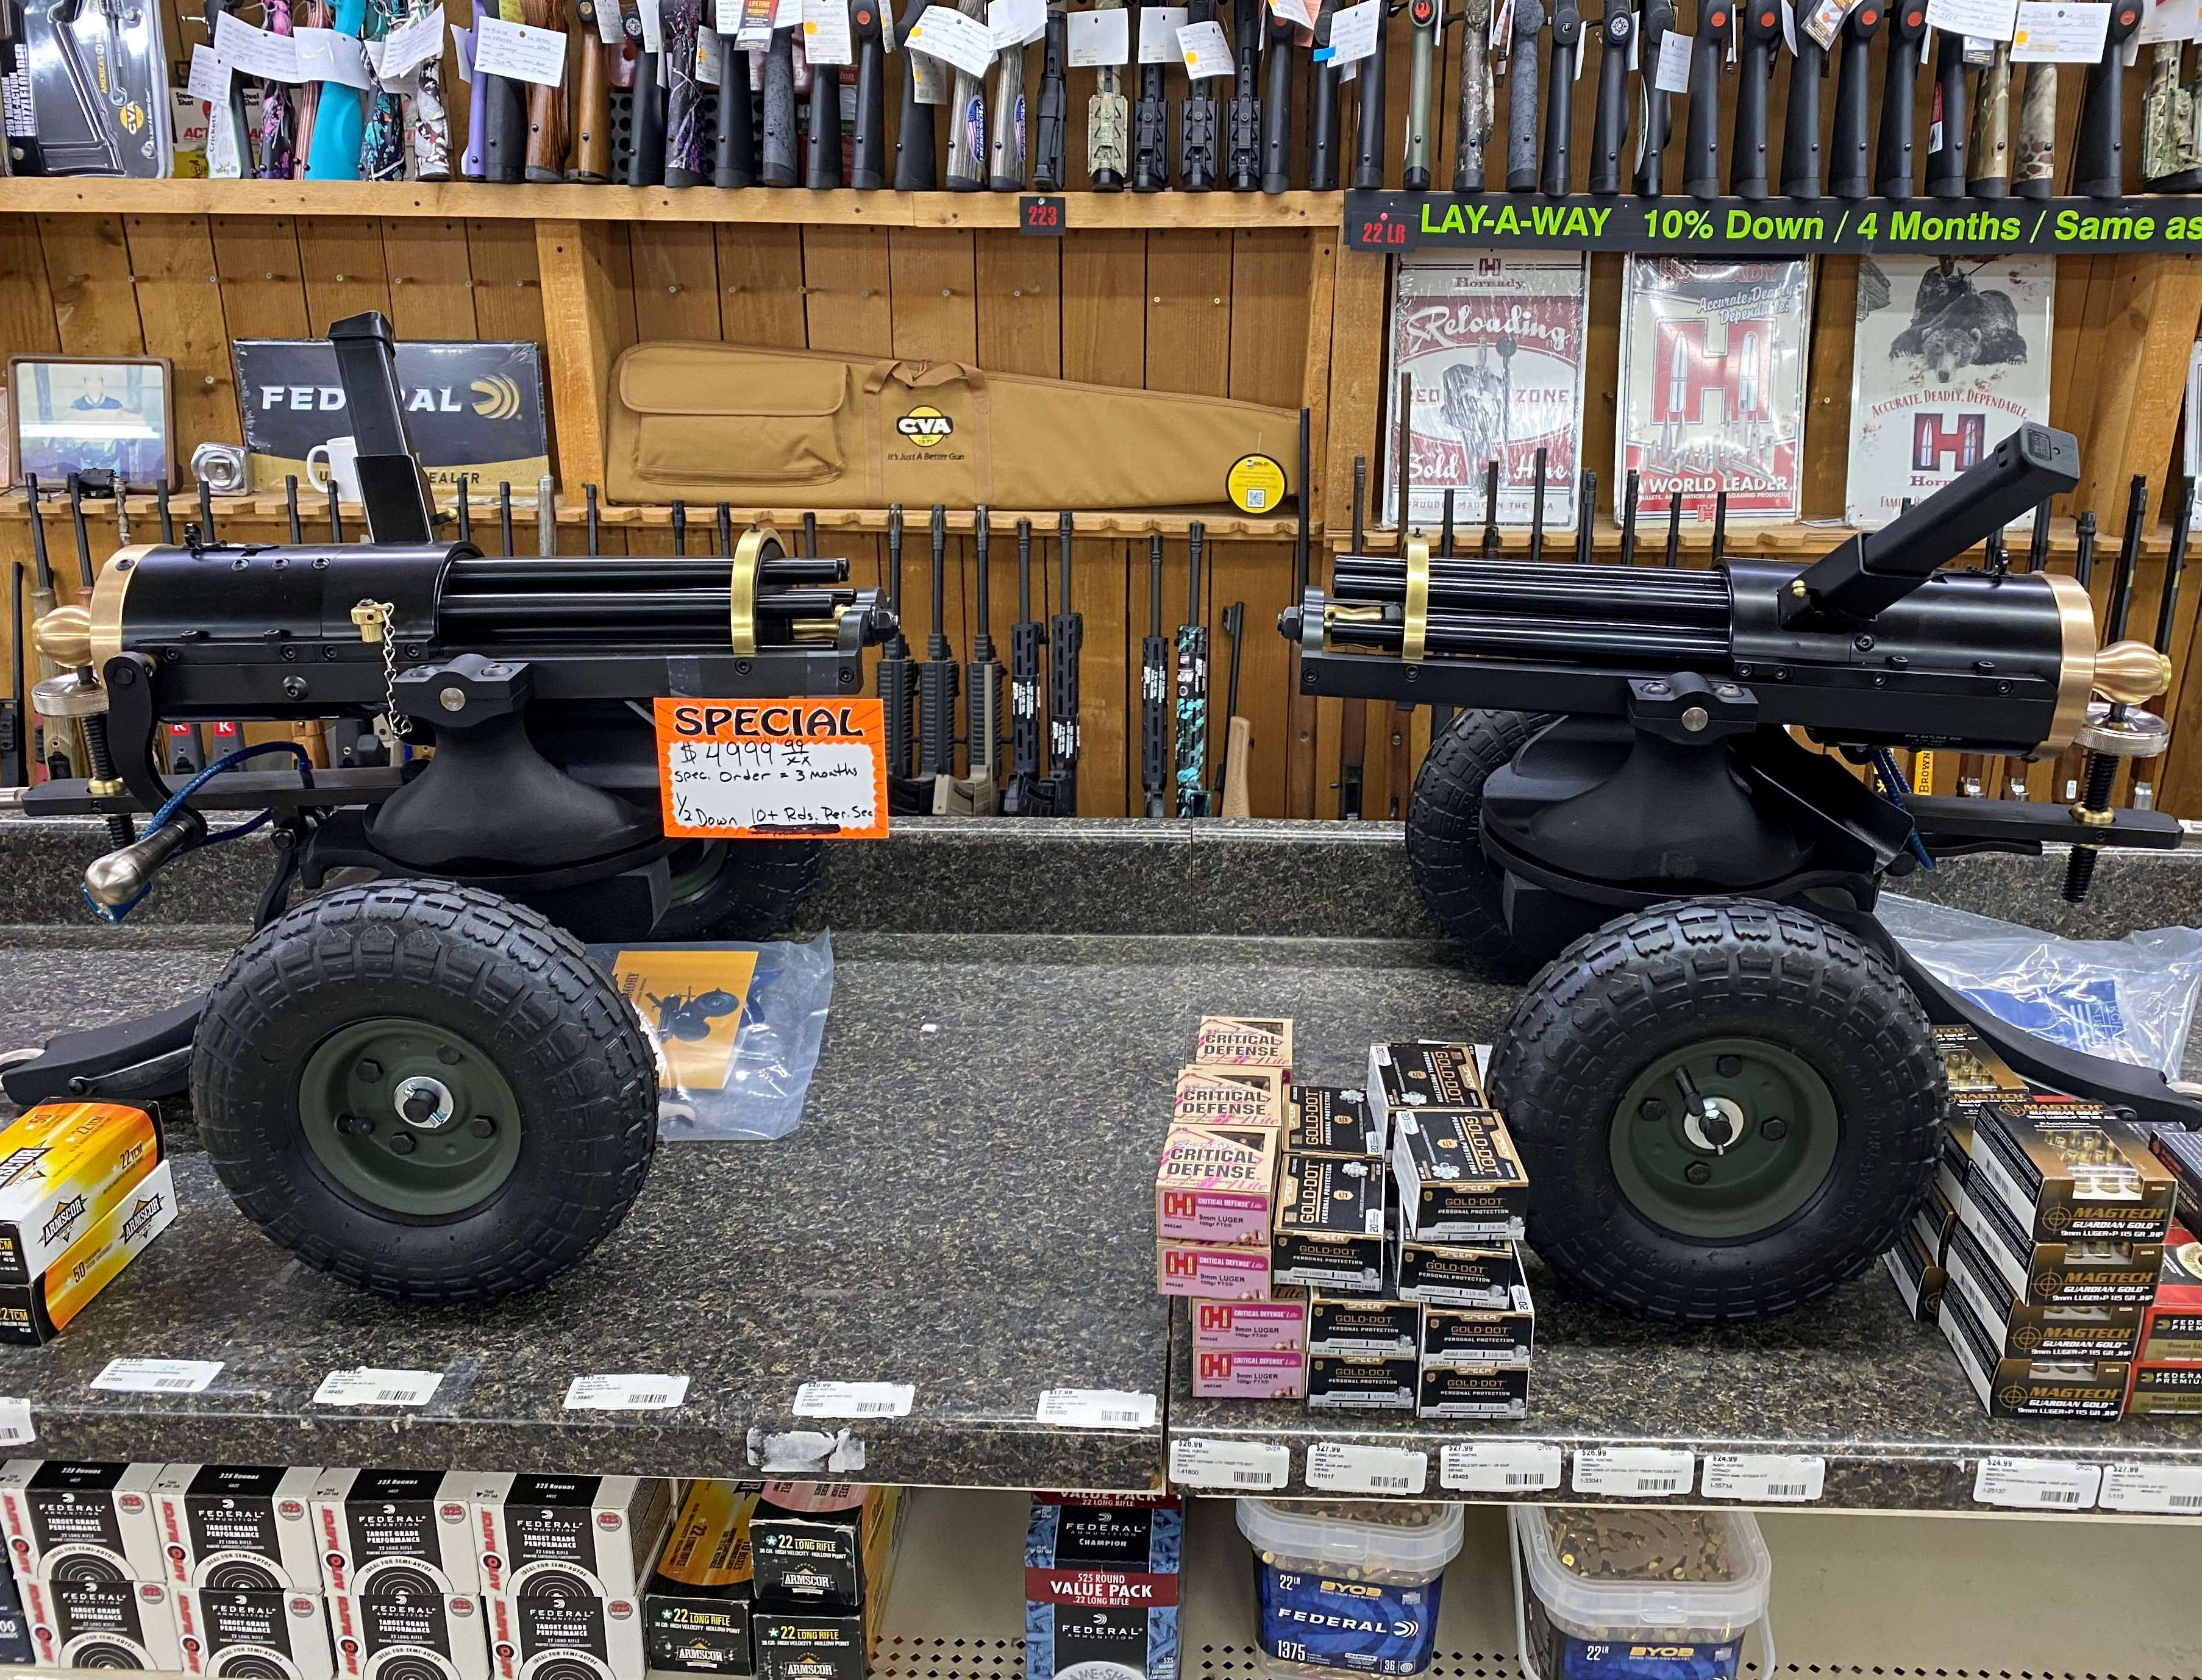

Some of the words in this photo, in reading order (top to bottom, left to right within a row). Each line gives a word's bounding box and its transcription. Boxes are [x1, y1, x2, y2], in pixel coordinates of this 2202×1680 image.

[1, 77, 13, 117] MAGNUM
[15, 44, 36, 137] MUZZLELOADER
[9, 73, 24, 137] BREAK-ACTION
[127, 101, 137, 135] CVA
[6, 119, 15, 137] 209
[1028, 205, 1058, 226] 223
[1420, 203, 1612, 237] LAY-A-WAY
[1644, 209, 1714, 240] 10%
[1726, 210, 1825, 240] Down
[1833, 210, 1850, 243] /
[1857, 212, 1878, 240] 4
[1889, 211, 2021, 241] Months
[2029, 210, 2047, 243] /
[2054, 210, 2156, 241] Same
[2165, 215, 2202, 241] as
[1361, 222, 1383, 243] 22
[1386, 224, 1405, 243] LR
[1453, 277, 1525, 290] Hornady
[1406, 305, 1571, 355] Reloading
[258, 385, 462, 412] FEDAL
[1516, 389, 1570, 404] ZONE
[1924, 390, 1964, 403] DEADLY.
[1967, 390, 2028, 420] DEPENDABLE.
[899, 418, 952, 433] CVA
[428, 472, 480, 485] EALER
[1650, 477, 1718, 494] WORLD
[1722, 476, 1788, 492] LEADER
[675, 707, 864, 737] SPECIAL
[719, 769, 771, 783] Order
[796, 770, 805, 782] 3
[695, 808, 738, 827] Down
[751, 807, 779, 824] 10+
[1205, 1034, 1278, 1045] CRITICAL
[1204, 1045, 1278, 1056] DEFENSE
[1183, 1091, 1265, 1103] CRITICAL
[1182, 1103, 1266, 1116] DEFENSE
[1170, 1148, 1257, 1164] CRITICAL
[1167, 1162, 1256, 1180] DEFENSE
[1198, 1197, 1223, 1206] CRITICAL
[1224, 1198, 1249, 1208] DEFENSE
[45, 1199, 84, 1242] ARMSCOR
[124, 1199, 161, 1240] ARMSCOR
[1218, 1216, 1244, 1224] LUGER
[2072, 1208, 2166, 1220] MAGTECH
[71, 1261, 88, 1284] 50
[2064, 1272, 2156, 1284] MAGTECH
[10, 1309, 28, 1322] TCM
[2043, 1328, 2134, 1339] MAGTECH
[2029, 1387, 2118, 1400] MAGTECH
[2028, 1400, 2081, 1408] GUARDIAN
[1987, 1459, 2013, 1467] $24.99
[39, 1504, 103, 1513] FEDERAL
[1066, 1523, 1145, 1532] FEDERAL
[778, 1534, 793, 1549] 22
[794, 1540, 815, 1551] LONG
[816, 1541, 836, 1552] RIFLE
[1079, 1539, 1127, 1547] CHAMPION
[784, 1573, 830, 1587] ARMSCOR
[1078, 1574, 1093, 1582] 525
[1096, 1575, 1125, 1583] ROUND
[1280, 1575, 1294, 1591] 22
[1050, 1581, 1104, 1596] VALUE
[1109, 1585, 1153, 1598] PACK
[1320, 1581, 1383, 1597] BYOB
[372, 1606, 435, 1614] FEDERAL
[1278, 1607, 1388, 1634] FEDERAL
[1062, 1625, 1142, 1636] FEDERAL
[678, 1648, 724, 1662] ARMSCOR
[1277, 1640, 1306, 1661] 1375
[1629, 1647, 1695, 1657] BYOB
[787, 1662, 833, 1676] ARMSCOR
